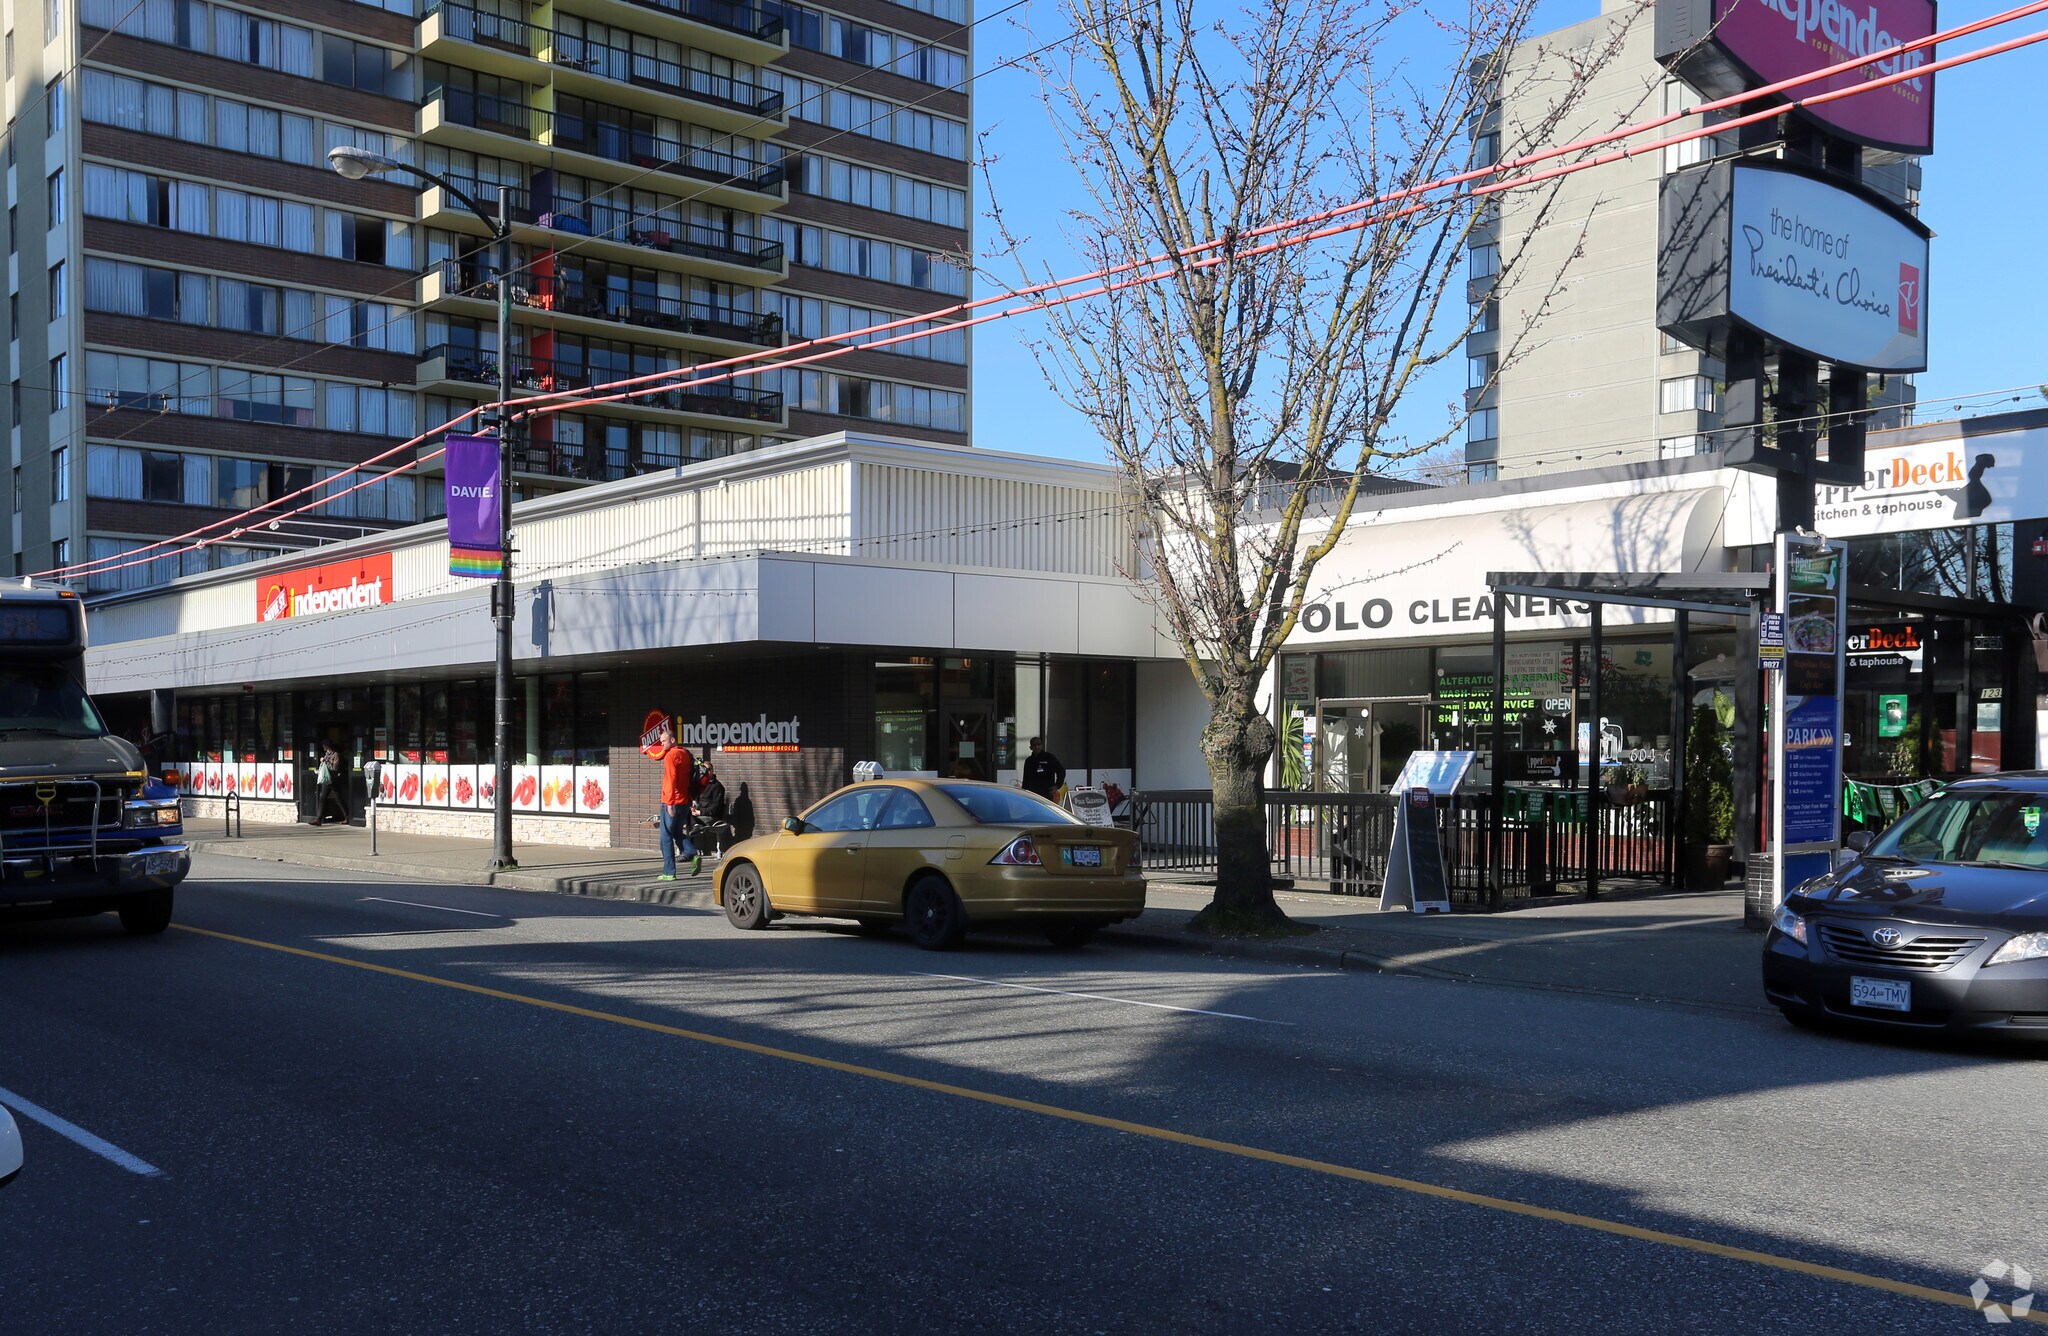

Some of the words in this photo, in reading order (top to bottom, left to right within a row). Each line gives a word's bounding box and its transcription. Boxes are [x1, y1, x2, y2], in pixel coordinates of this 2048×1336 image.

[1811, 38, 1834, 55] YOUR
[1770, 207, 1792, 241] the
[1795, 215, 1834, 255] home
[1835, 233, 1849, 260] of
[1836, 267, 1891, 318] Choice
[1815, 452, 1965, 506] pperDeck
[451, 485, 494, 498] DAVIE.
[1862, 504, 1872, 515] &
[1876, 499, 1943, 516] taphouse
[289, 575, 382, 617] independent
[1281, 597, 1393, 633] OLO
[1409, 594, 1594, 625] CLEANERS
[1846, 625, 1920, 650] erDeck
[1763, 660, 1780, 668] 9027
[1850, 658, 1857, 666] &
[1859, 657, 1904, 668] taphouse
[1440, 673, 1509, 686] ALTERATIOS
[1511, 674, 1519, 684] &
[1519, 672, 1567, 683] REPAIRS
[1982, 688, 2002, 698] 123
[1469, 700, 1487, 710] DAY
[1490, 699, 1535, 710] SRVICE
[1545, 698, 1571, 711] OPEN
[641, 726, 661, 750] DAVIE
[661, 718, 670, 733] ST
[676, 714, 800, 751] independent
[1786, 728, 1817, 746] PARK
[1629, 748, 1670, 762] 604-6
[1063, 849, 1071, 859] N
